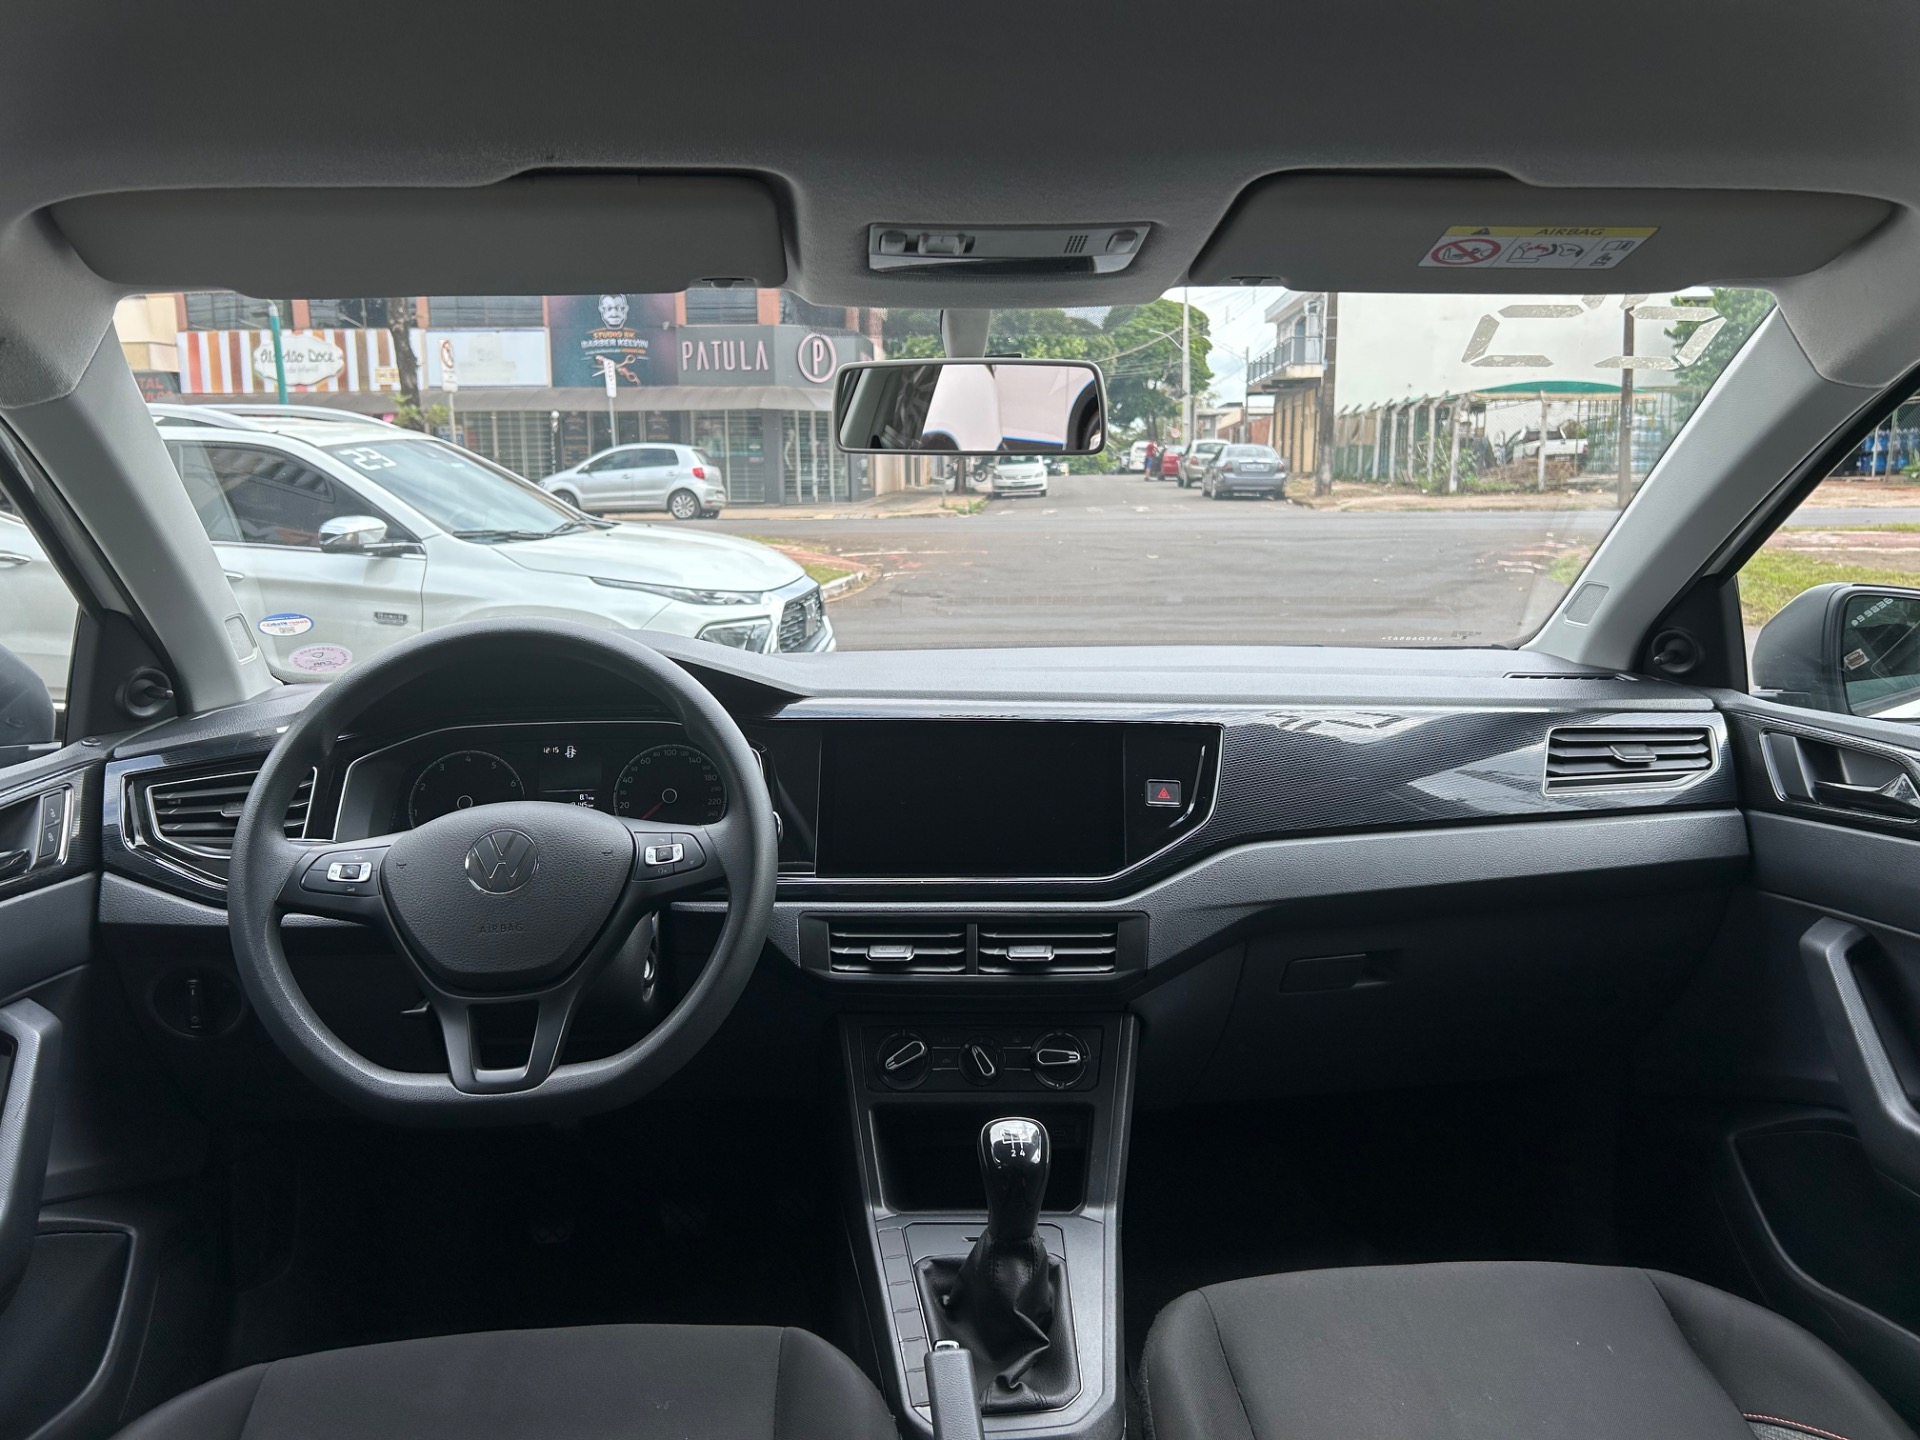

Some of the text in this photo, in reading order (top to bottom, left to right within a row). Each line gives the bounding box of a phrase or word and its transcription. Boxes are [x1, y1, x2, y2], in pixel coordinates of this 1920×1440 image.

[1536, 228, 1606, 236] AIRBAG
[580, 338, 616, 349] BARBER
[308, 348, 335, 363] Doce
[681, 339, 770, 372] PATULA
[480, 923, 523, 933] AIRBAG
